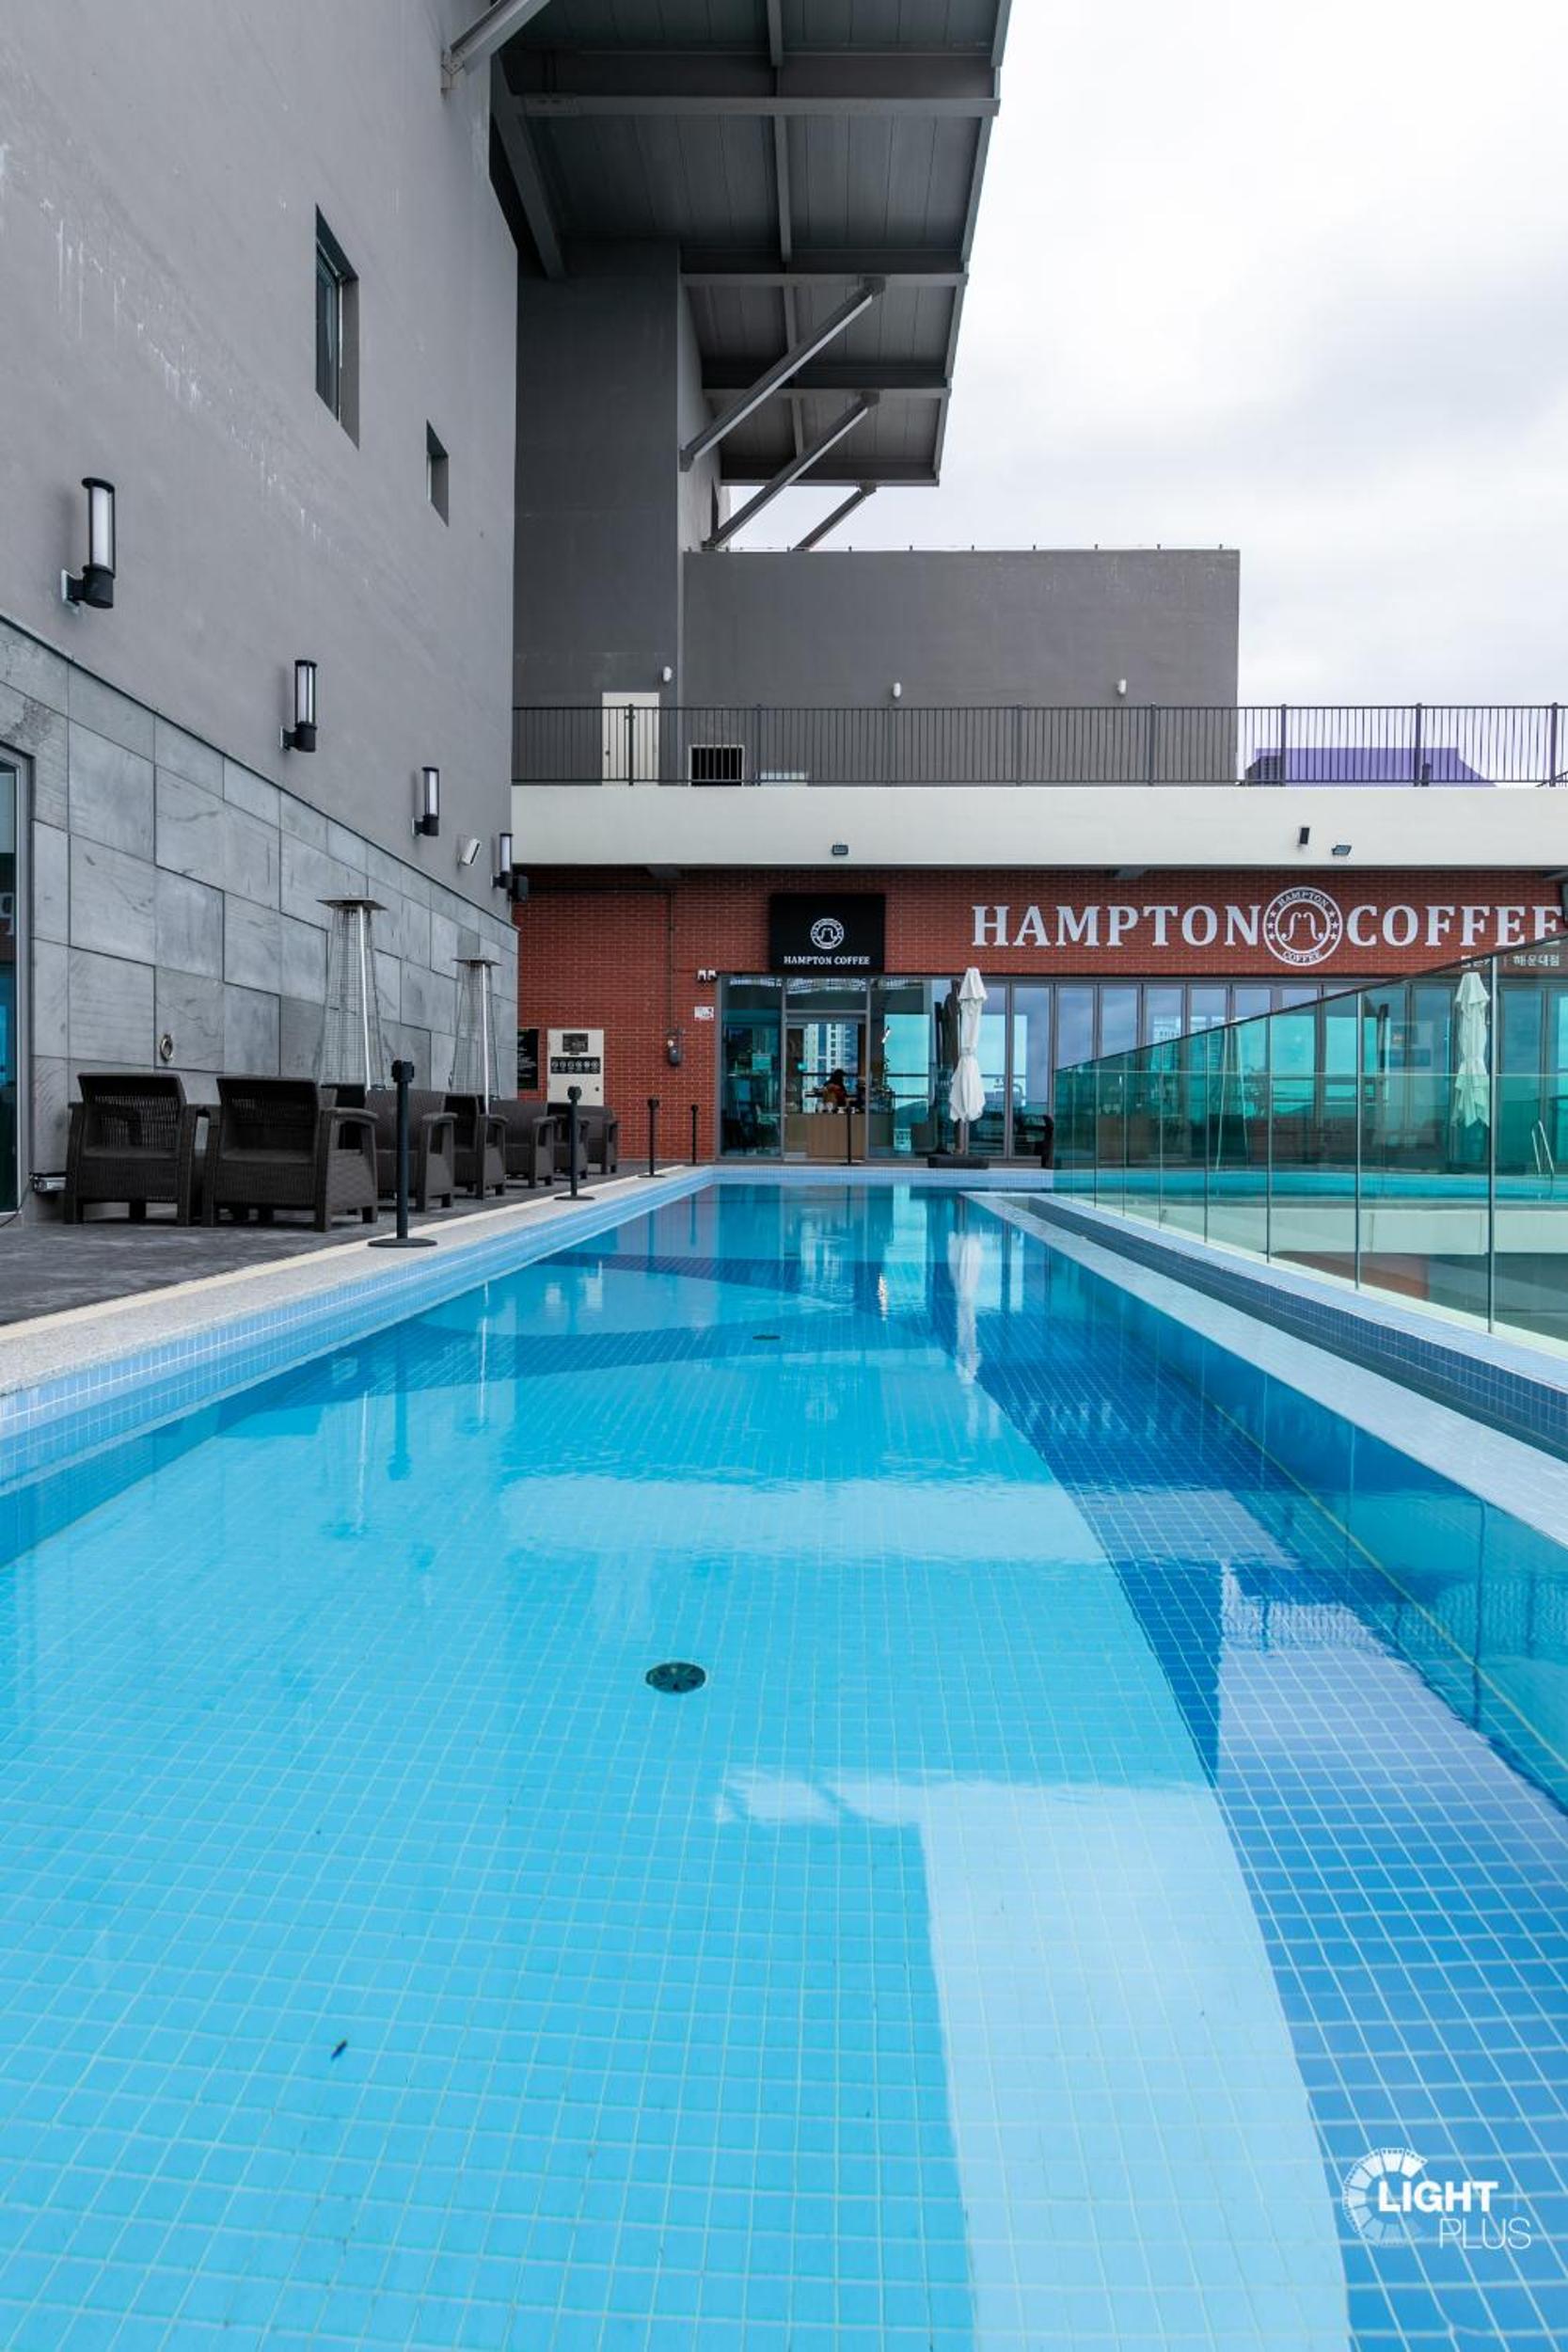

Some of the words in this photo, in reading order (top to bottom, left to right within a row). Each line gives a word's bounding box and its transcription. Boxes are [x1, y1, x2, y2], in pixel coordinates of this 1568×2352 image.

[1277, 891, 1329, 908] HAMPTON
[972, 905, 1261, 946] HAMPTON
[1346, 904, 1562, 946] COFFEE
[783, 955, 832, 965] HAMPTON
[833, 955, 870, 965] COFFEE
[1282, 949, 1323, 963] COFFEE
[1513, 953, 1560, 967] 해운대점
